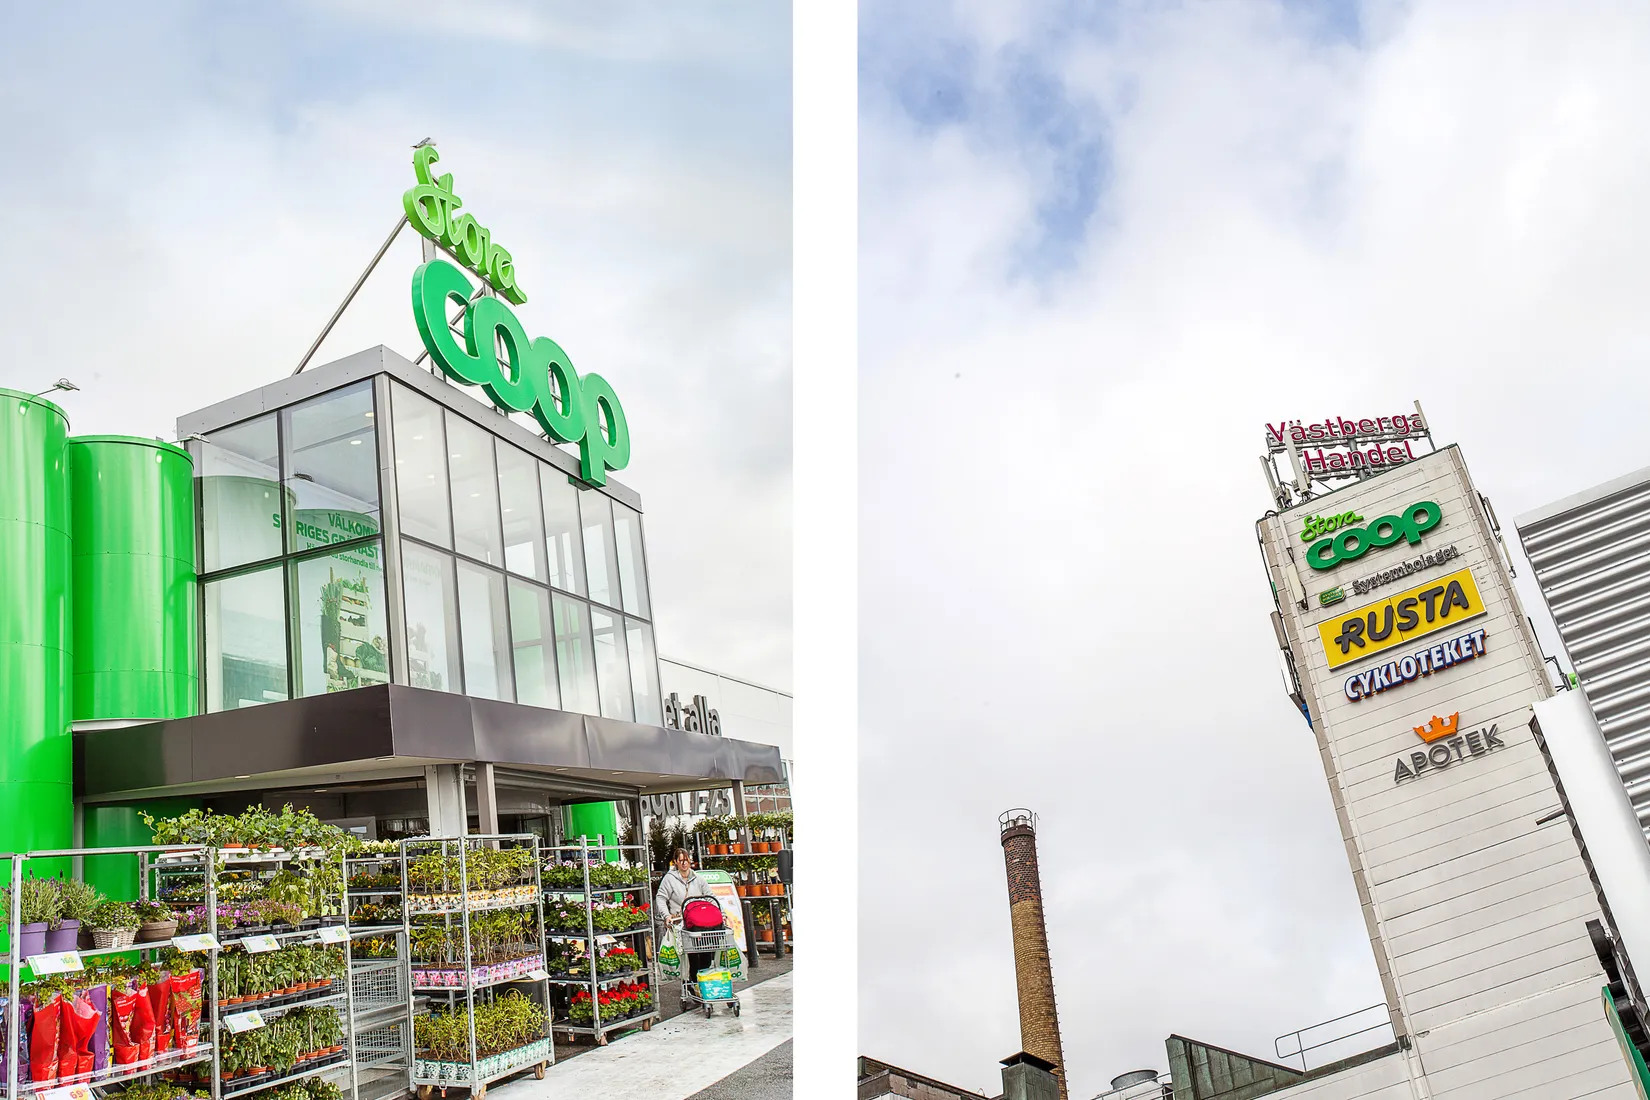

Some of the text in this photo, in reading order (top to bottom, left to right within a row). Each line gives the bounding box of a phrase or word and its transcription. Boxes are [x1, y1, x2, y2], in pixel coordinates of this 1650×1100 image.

[402, 144, 528, 307] Stora
[1266, 413, 1424, 443] Västberga
[1303, 440, 1417, 472] Handel
[1300, 509, 1364, 541] Stora
[1305, 500, 1442, 570] coop
[1351, 544, 1460, 595] Systembolaget
[1334, 579, 1471, 655] RUSTA
[1344, 628, 1488, 702] CYKLOTEKET
[1394, 723, 1505, 783] APOTEK
[70, 1090, 84, 1099] 69
